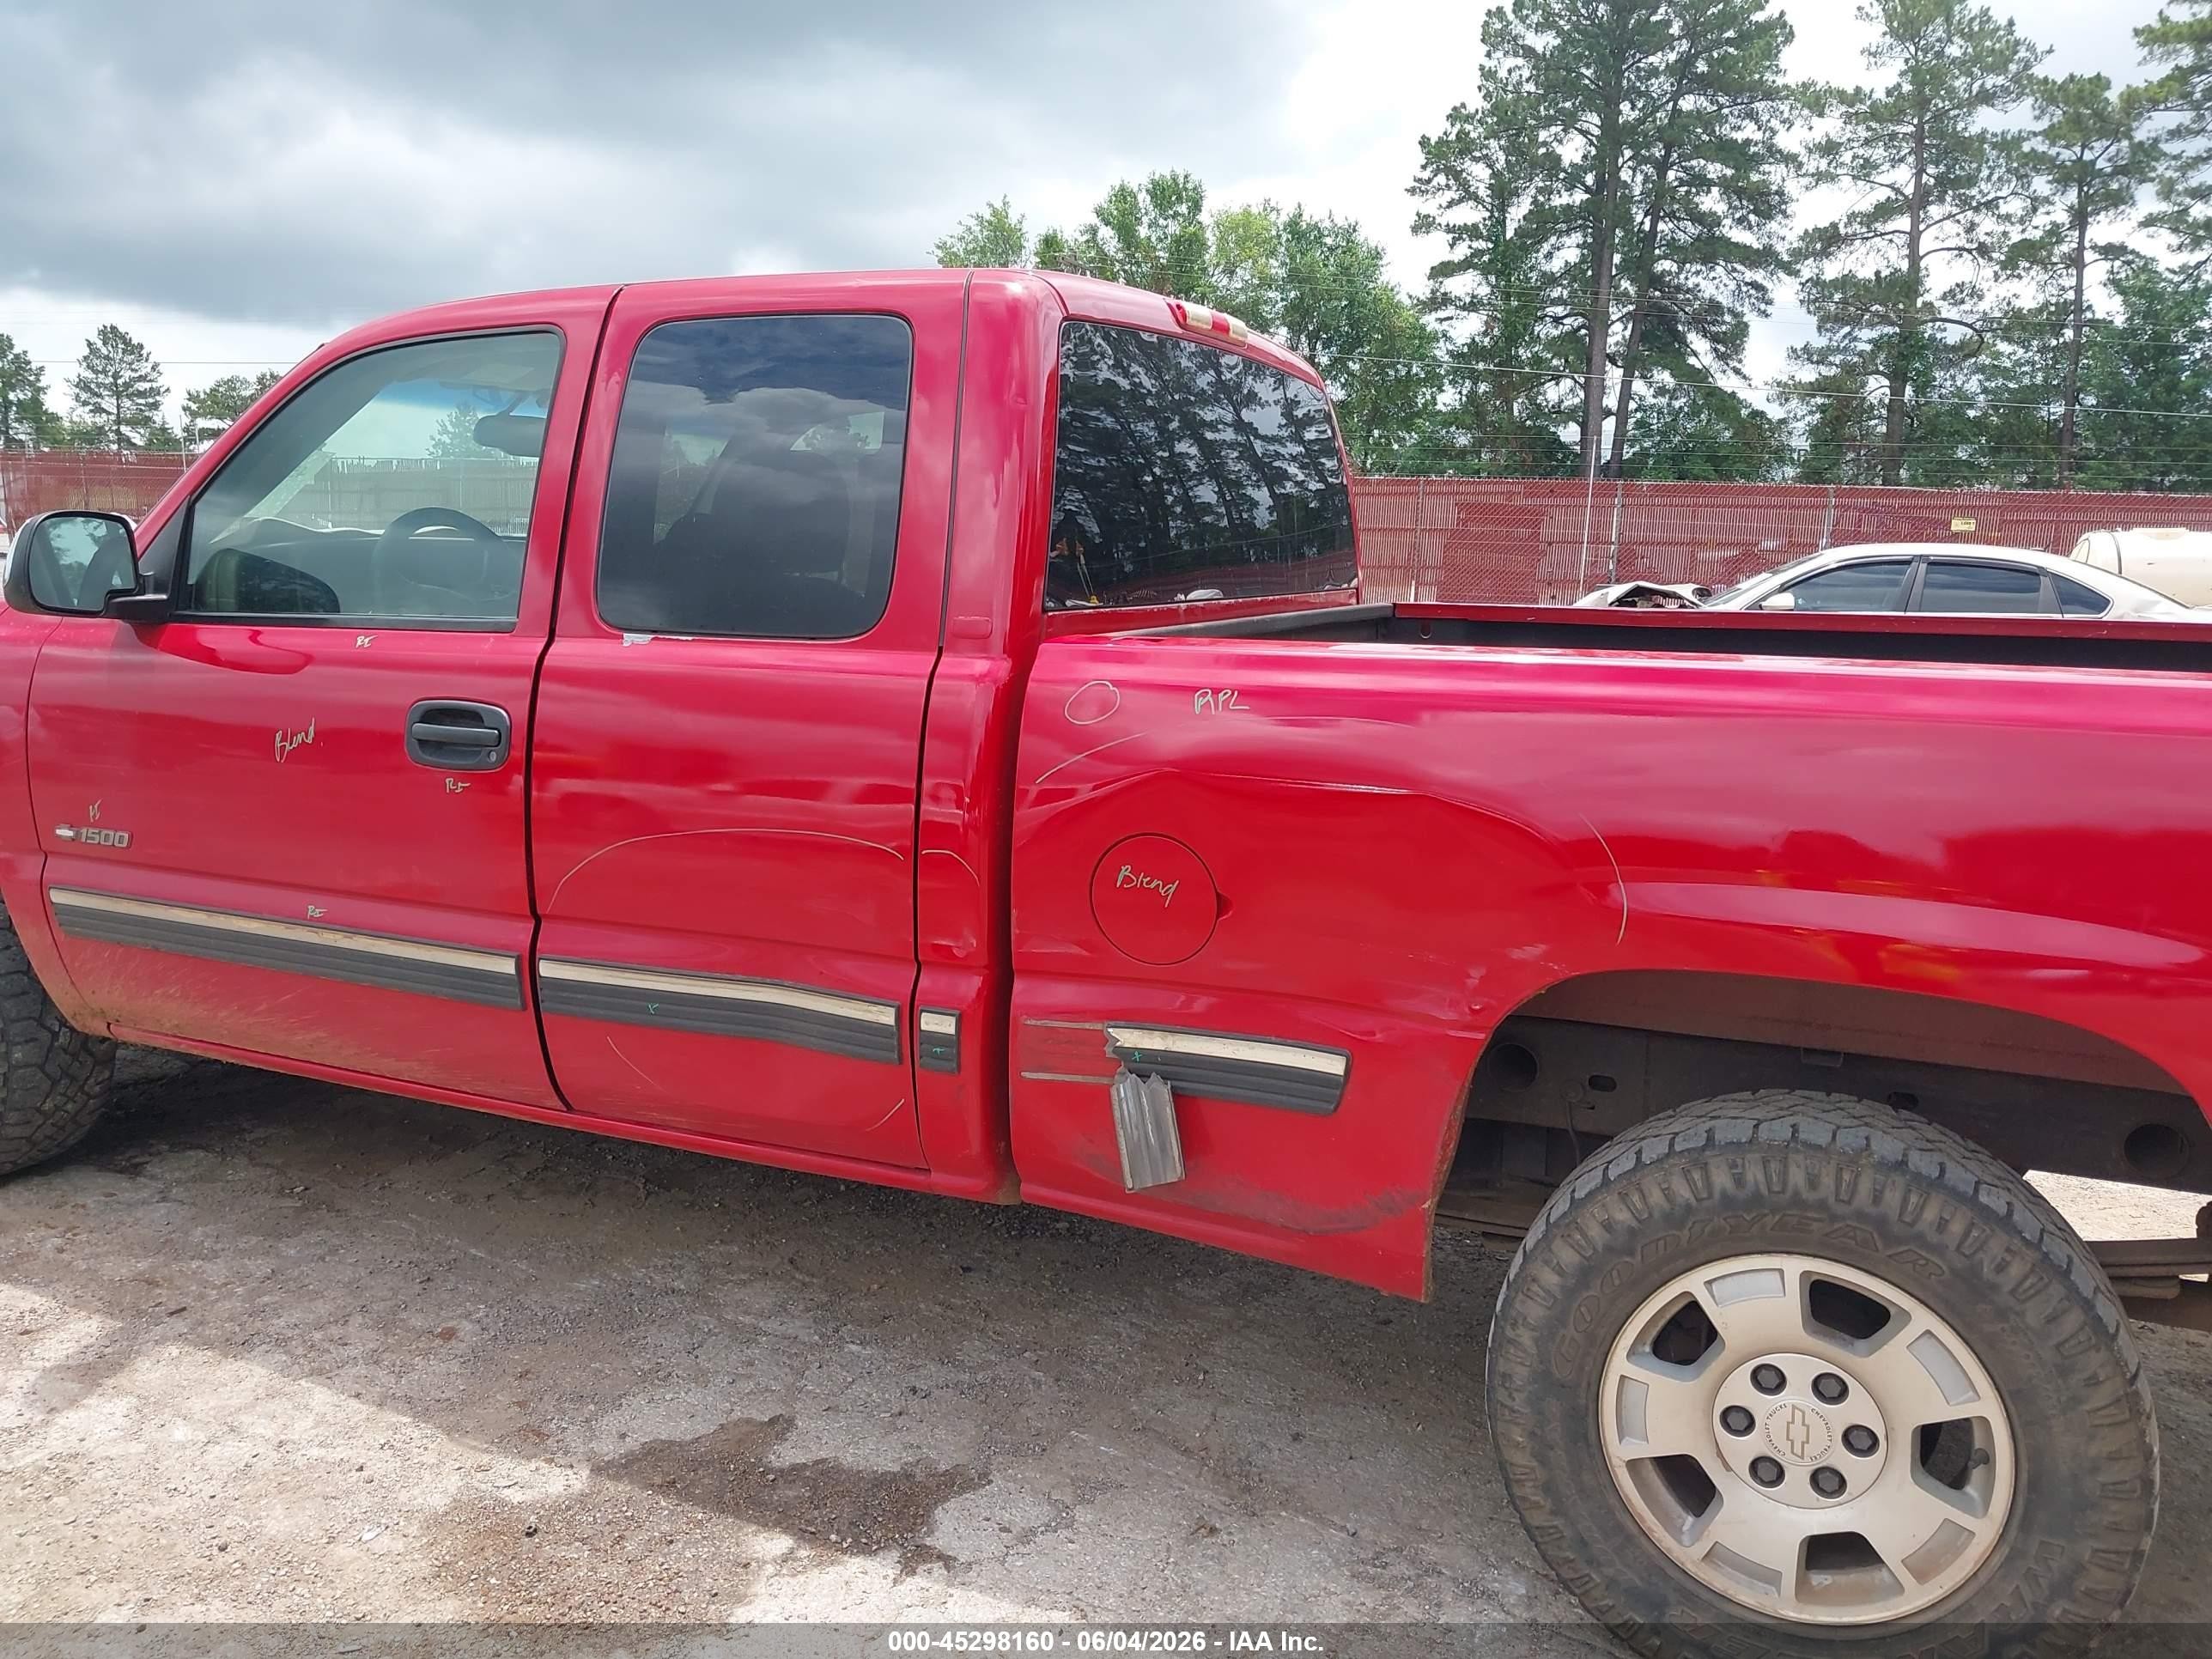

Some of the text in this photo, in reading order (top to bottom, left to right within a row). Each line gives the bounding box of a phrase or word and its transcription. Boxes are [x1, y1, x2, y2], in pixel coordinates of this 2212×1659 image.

[275, 716, 315, 763] Blend
[81, 826, 130, 848] 1500
[1116, 865, 1180, 908] Blend
[1553, 1212, 1947, 1376] GOODYEAR
[1765, 1421, 1787, 1457] CHEVROLET
[1810, 1408, 1832, 1443] CHEVROLET
